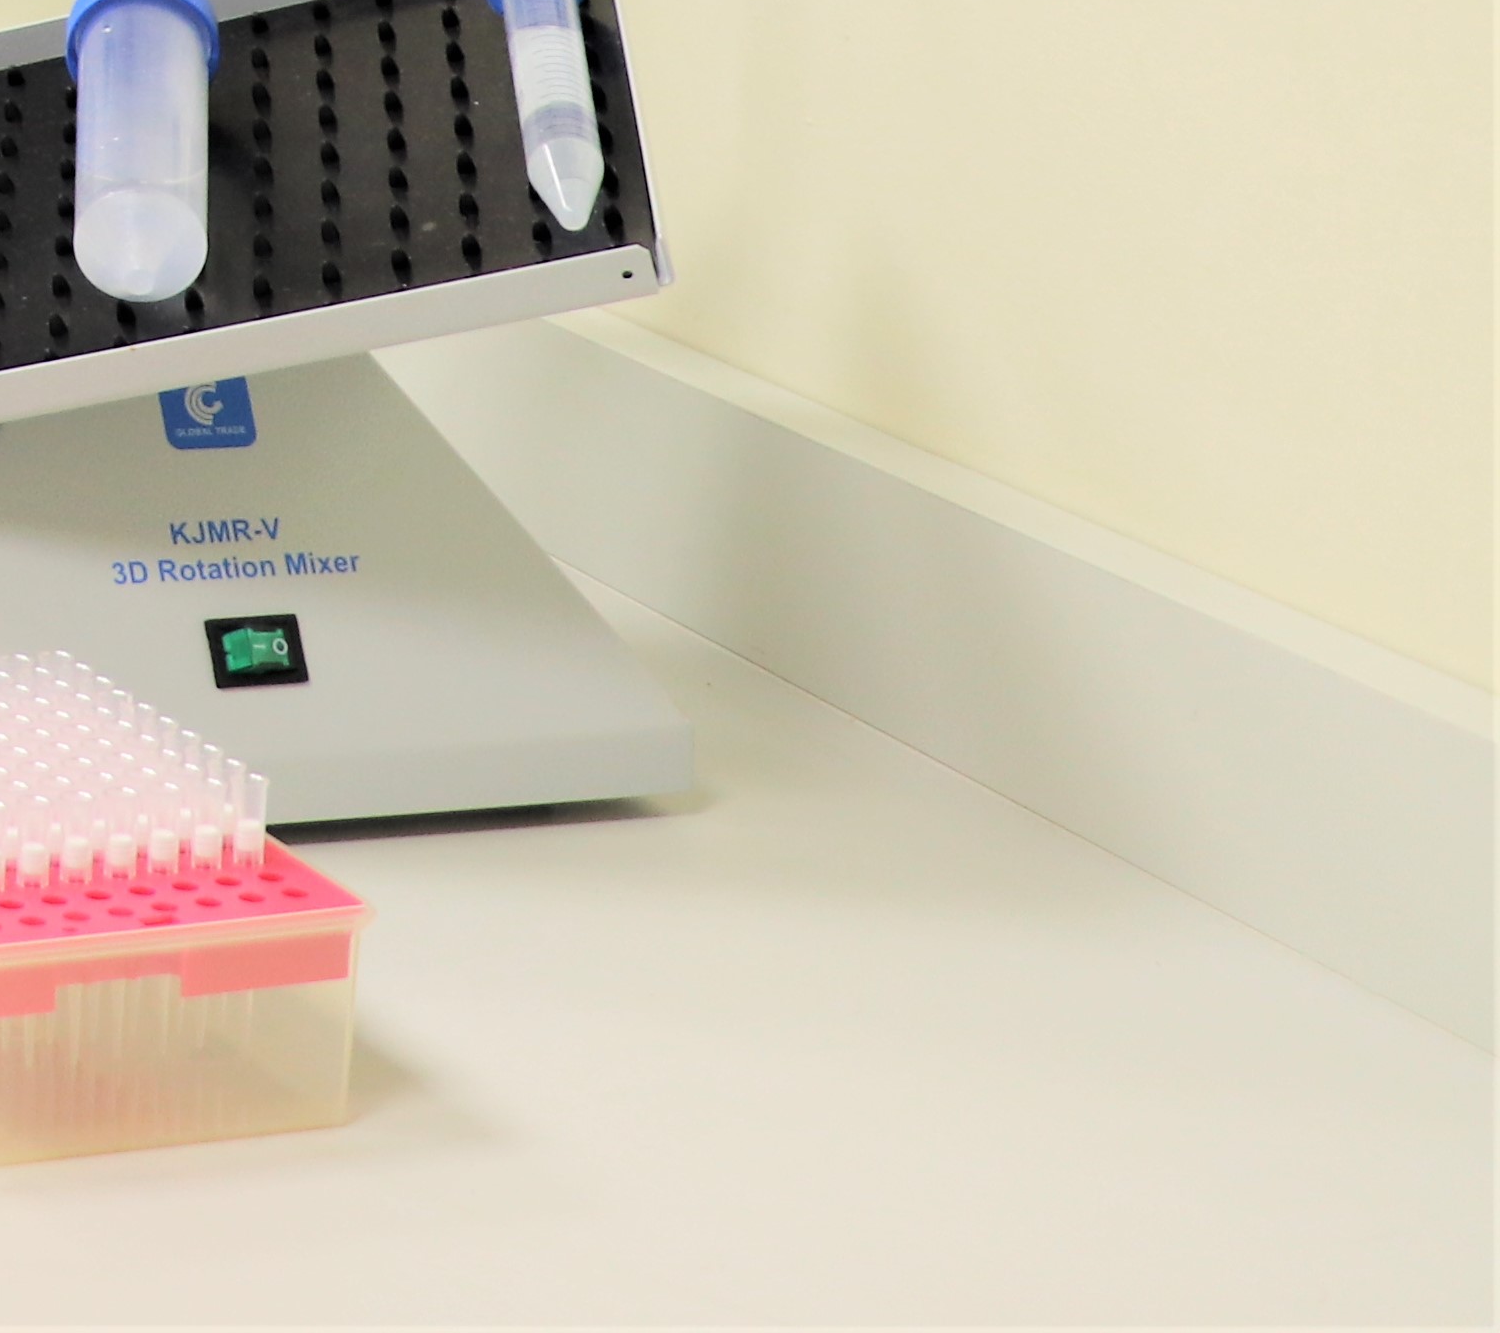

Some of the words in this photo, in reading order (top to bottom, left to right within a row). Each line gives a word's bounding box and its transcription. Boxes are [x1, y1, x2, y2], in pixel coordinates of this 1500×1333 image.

[175, 426, 213, 438] GLOBAL
[169, 517, 280, 545] KJMR-V
[112, 561, 148, 585] 3D
[158, 556, 276, 582] Rotation
[284, 552, 360, 575] Mixer
